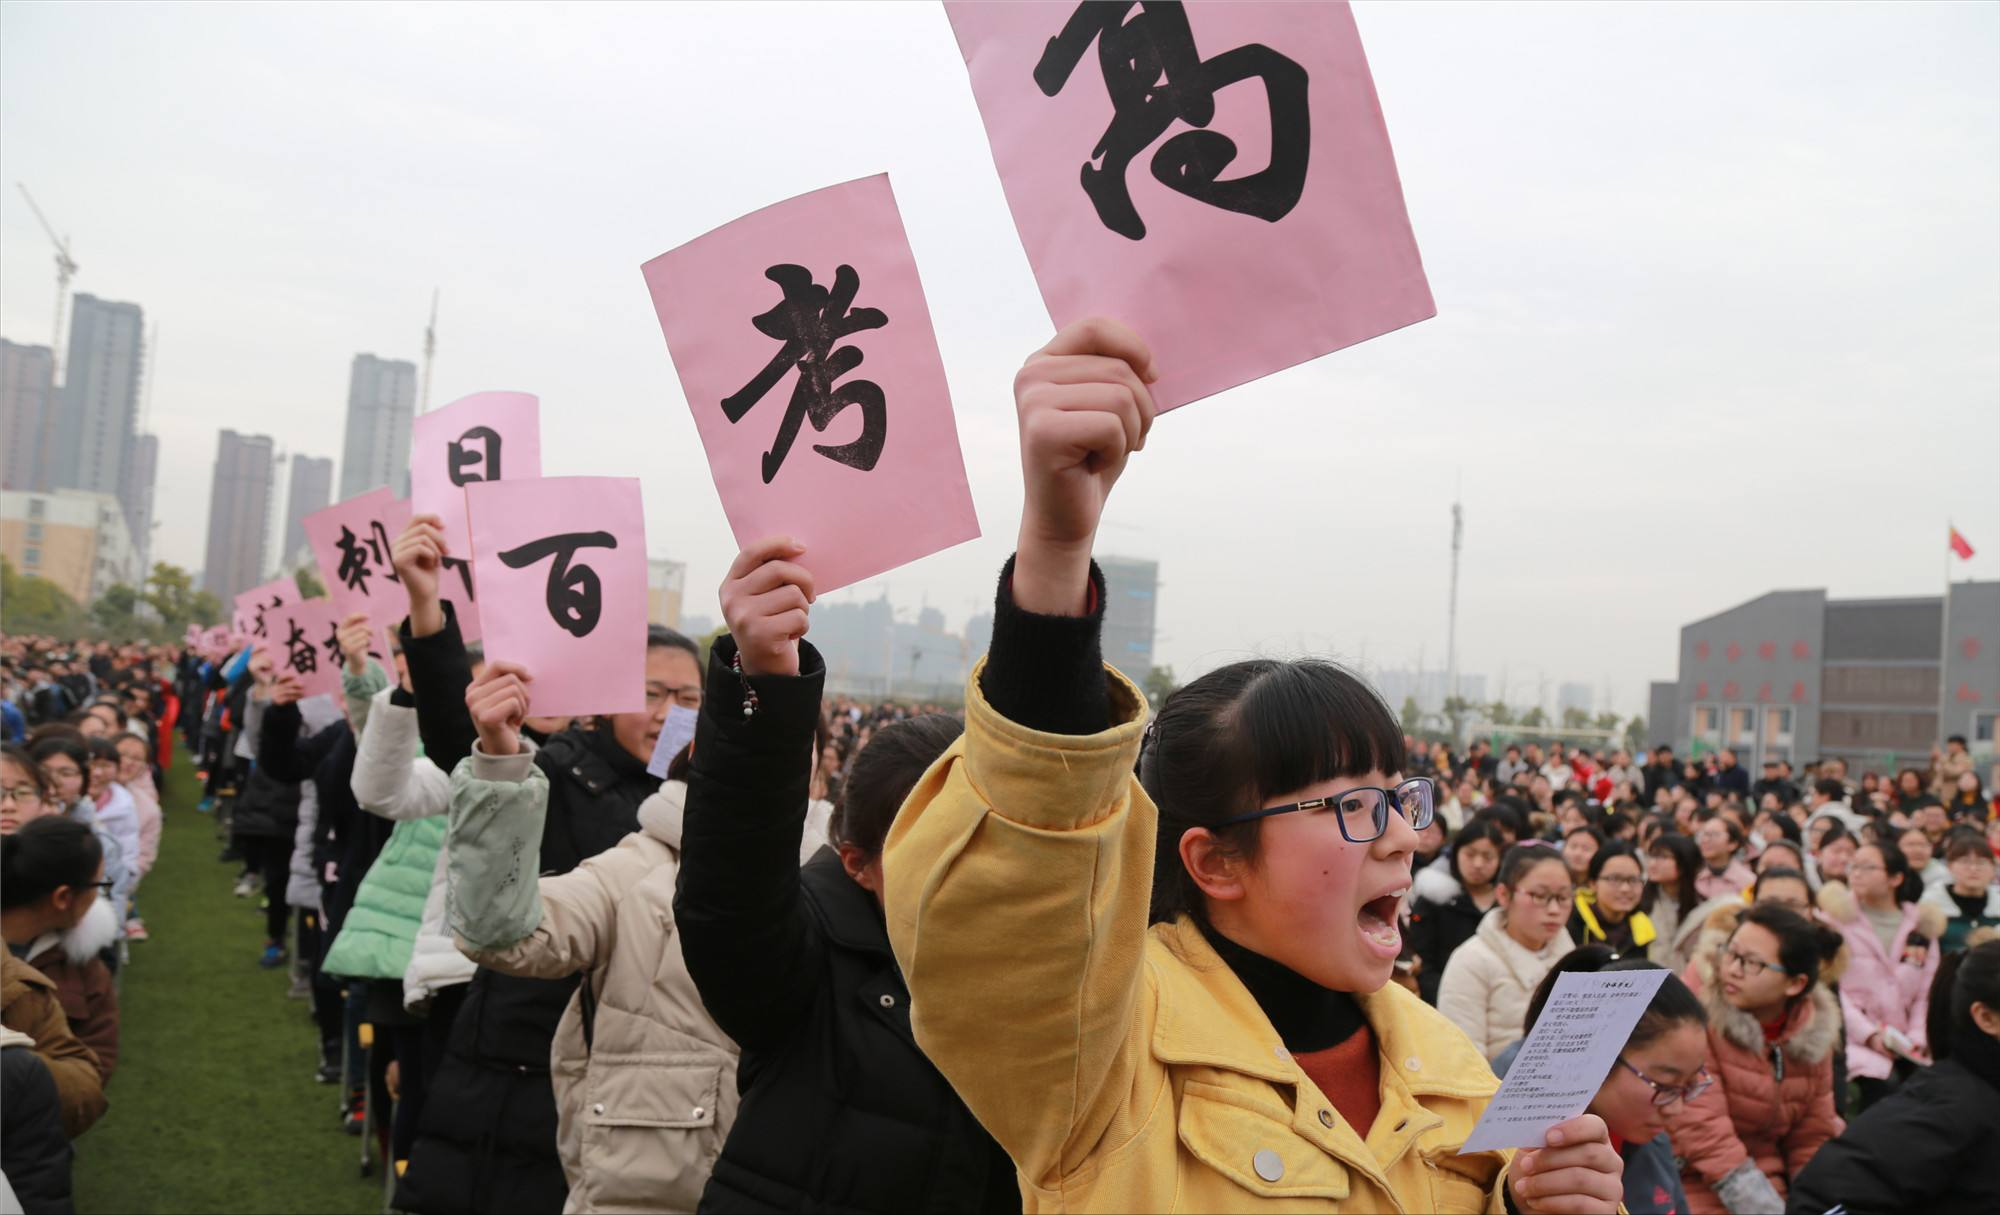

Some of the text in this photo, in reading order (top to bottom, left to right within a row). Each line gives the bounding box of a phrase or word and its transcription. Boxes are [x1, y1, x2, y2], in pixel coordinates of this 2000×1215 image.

[1034, 0, 1310, 240] 高
[721, 264, 888, 484] 考
[447, 426, 502, 486] 日
[335, 520, 400, 595] 刺
[498, 531, 617, 637] 百
[284, 619, 317, 674] 奋
